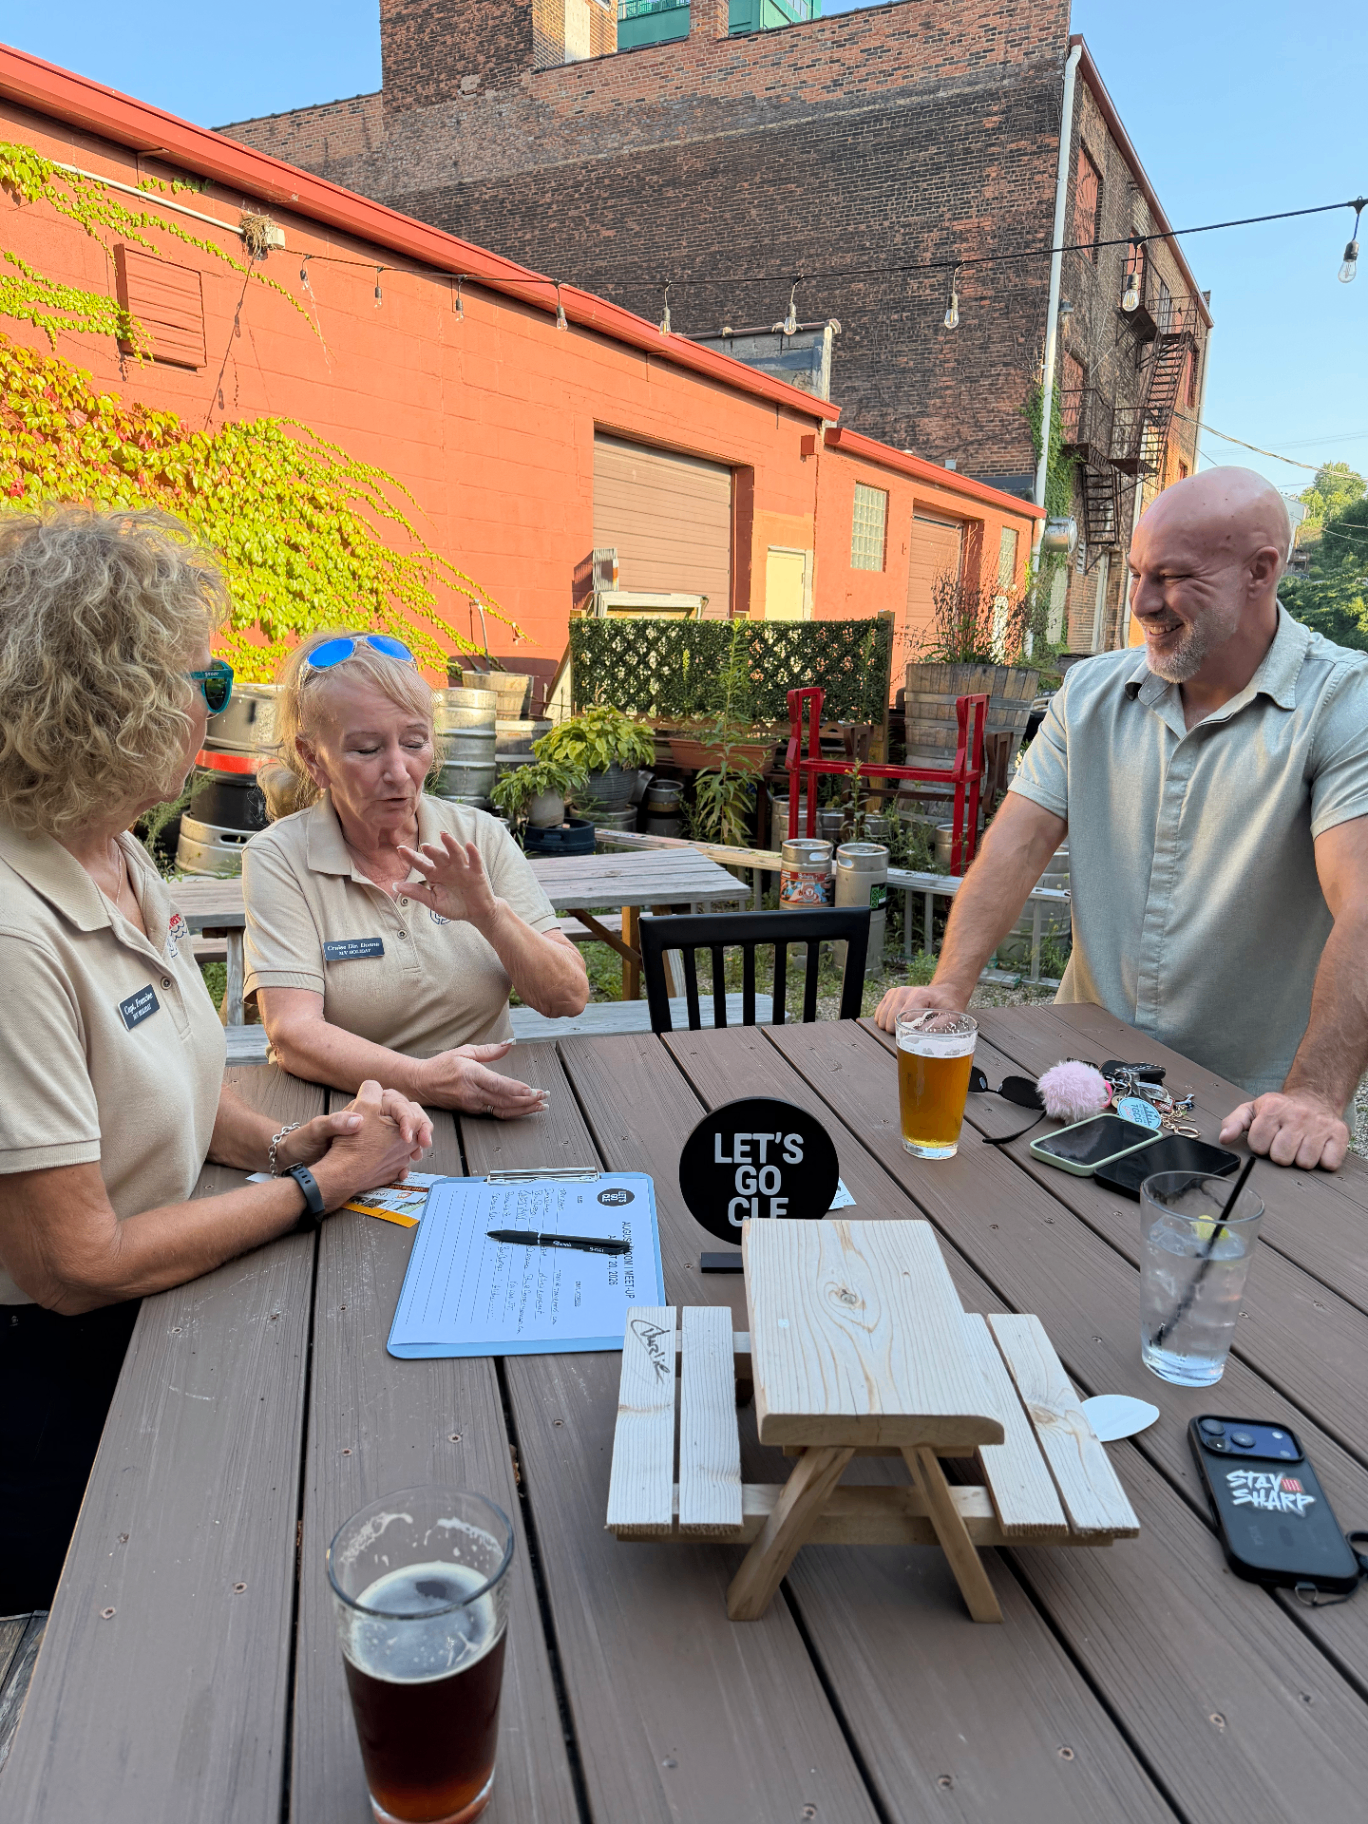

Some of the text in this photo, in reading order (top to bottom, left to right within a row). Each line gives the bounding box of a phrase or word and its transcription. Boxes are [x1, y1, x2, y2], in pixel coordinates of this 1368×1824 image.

[714, 1132, 804, 1165] LET'S
[734, 1165, 782, 1196] GO
[622, 1221, 632, 1244] AUGUS
[1226, 1469, 1285, 1493] STAY
[1232, 1488, 1316, 1517] SHARP
